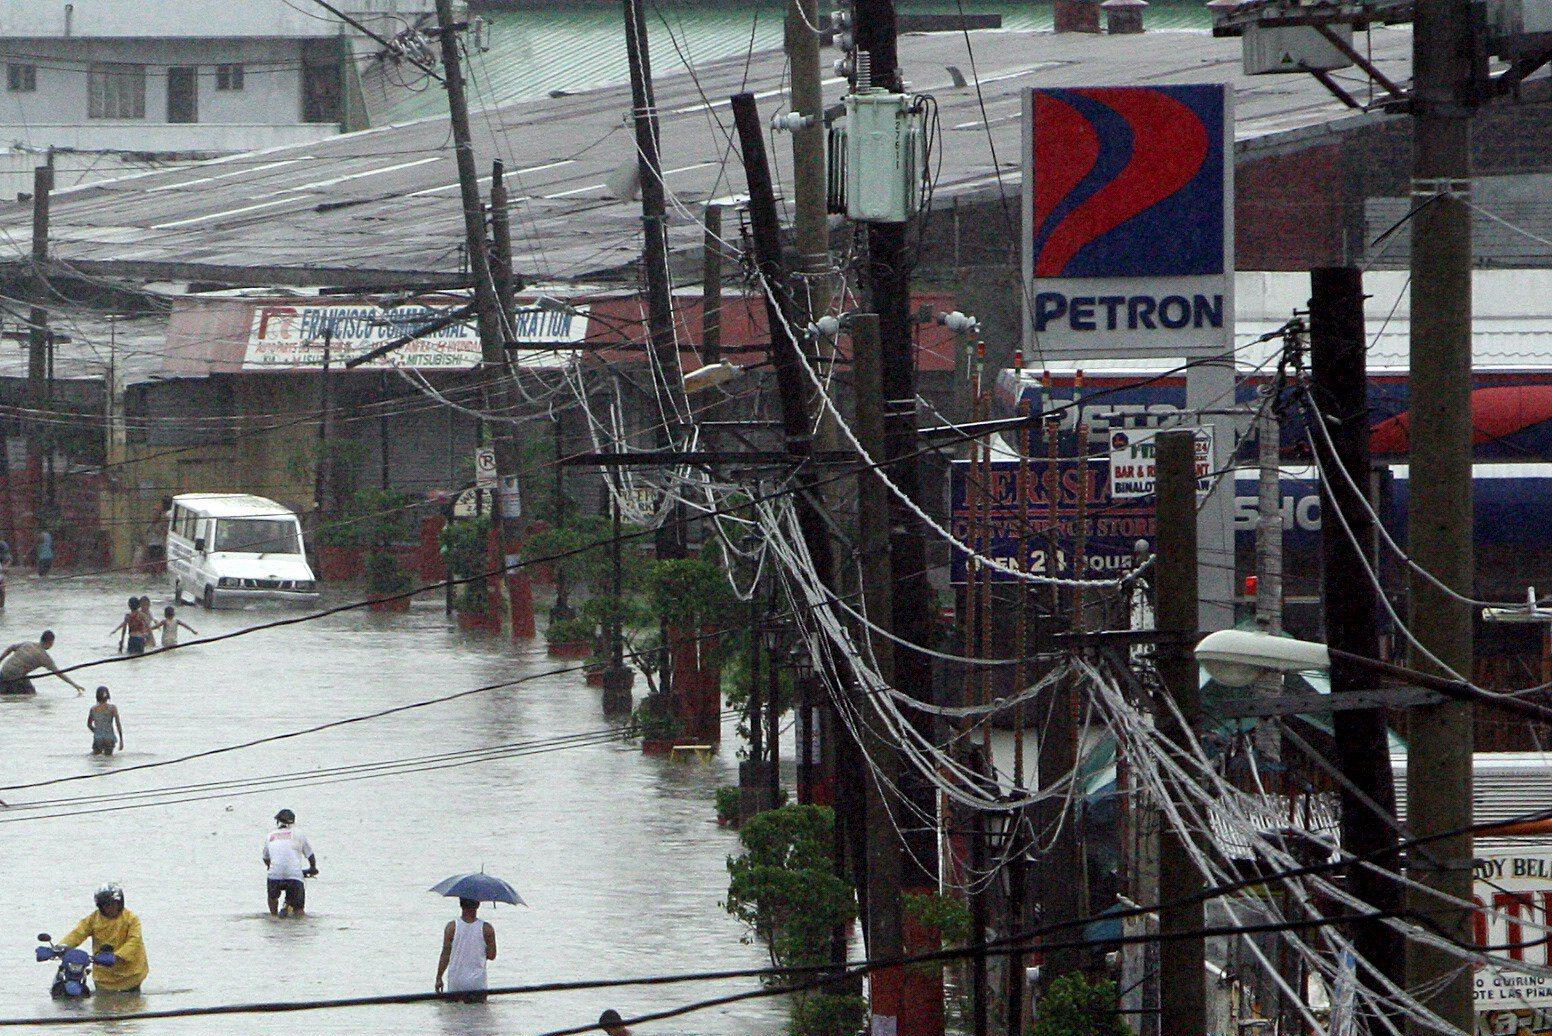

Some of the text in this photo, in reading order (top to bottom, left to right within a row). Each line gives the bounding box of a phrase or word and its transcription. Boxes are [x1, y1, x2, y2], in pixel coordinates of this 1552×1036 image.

[1034, 291, 1224, 332] PETRON
[300, 307, 375, 340] FRANCISCO
[1115, 465, 1135, 479] BAR
[1137, 465, 1145, 478] &
[965, 556, 1020, 573] OEN
[1514, 857, 1552, 878] BEL
